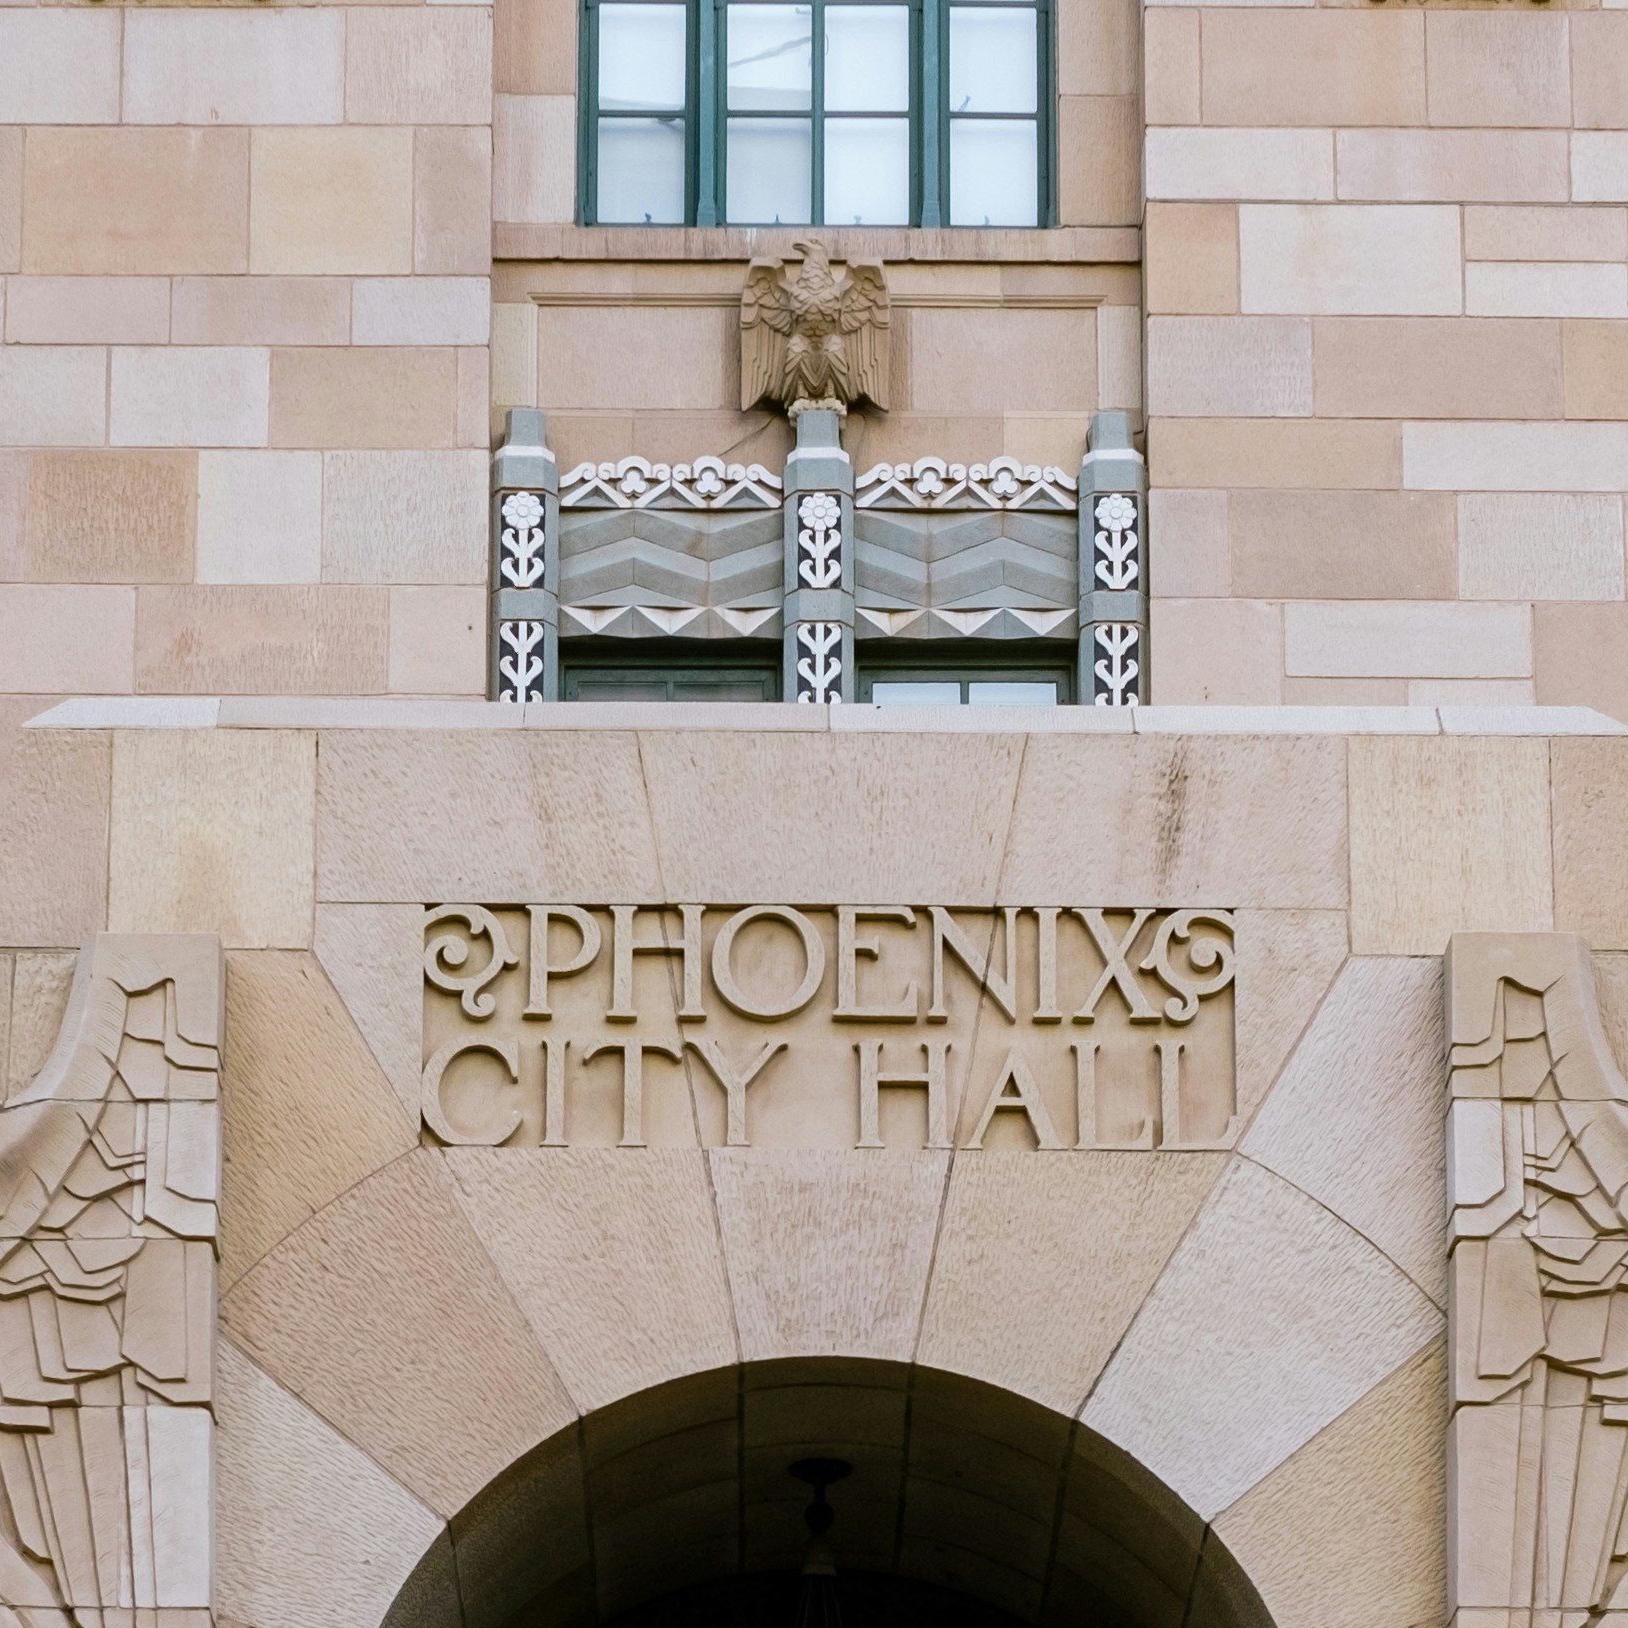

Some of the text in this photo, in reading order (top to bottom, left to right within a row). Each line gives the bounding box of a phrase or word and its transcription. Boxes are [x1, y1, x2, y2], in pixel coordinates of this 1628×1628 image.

[522, 904, 1162, 1025] PHOENIX
[419, 1039, 1238, 1150] CITY HALL
